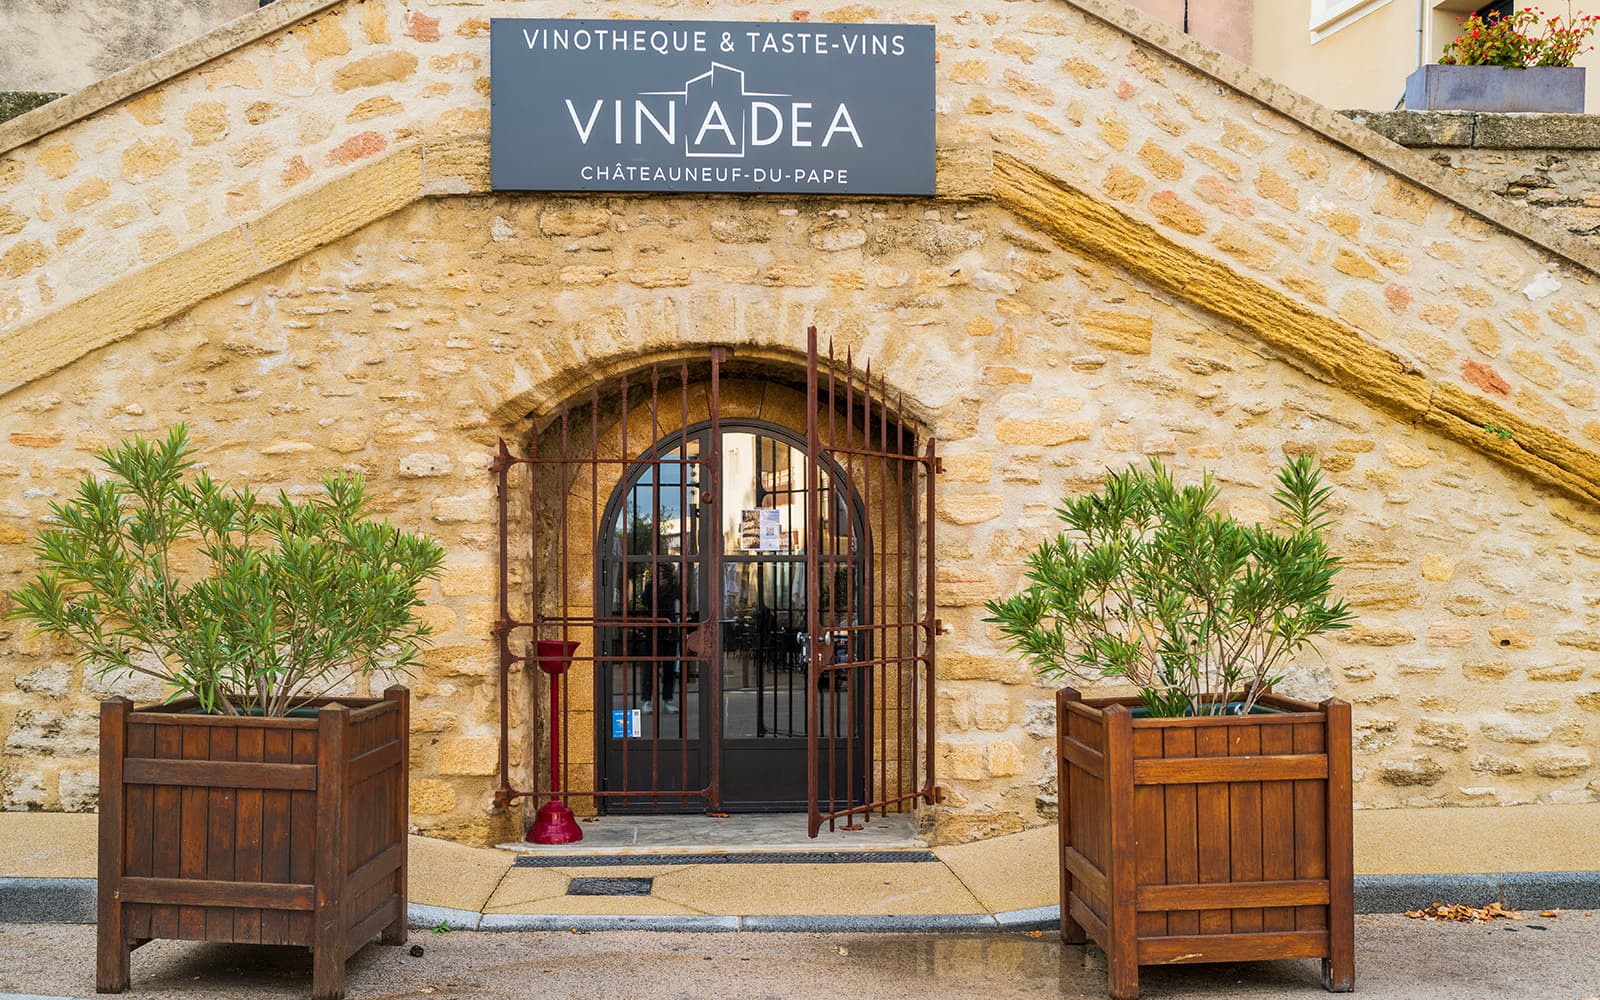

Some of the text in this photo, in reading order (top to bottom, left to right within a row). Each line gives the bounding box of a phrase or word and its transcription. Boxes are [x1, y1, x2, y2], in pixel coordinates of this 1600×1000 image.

[523, 29, 905, 56] VINOTHEQUE & TASTE-VINS
[565, 99, 864, 148] VINADEA
[580, 163, 848, 184] CHÂTEAUNEUF-DU-PAPE
